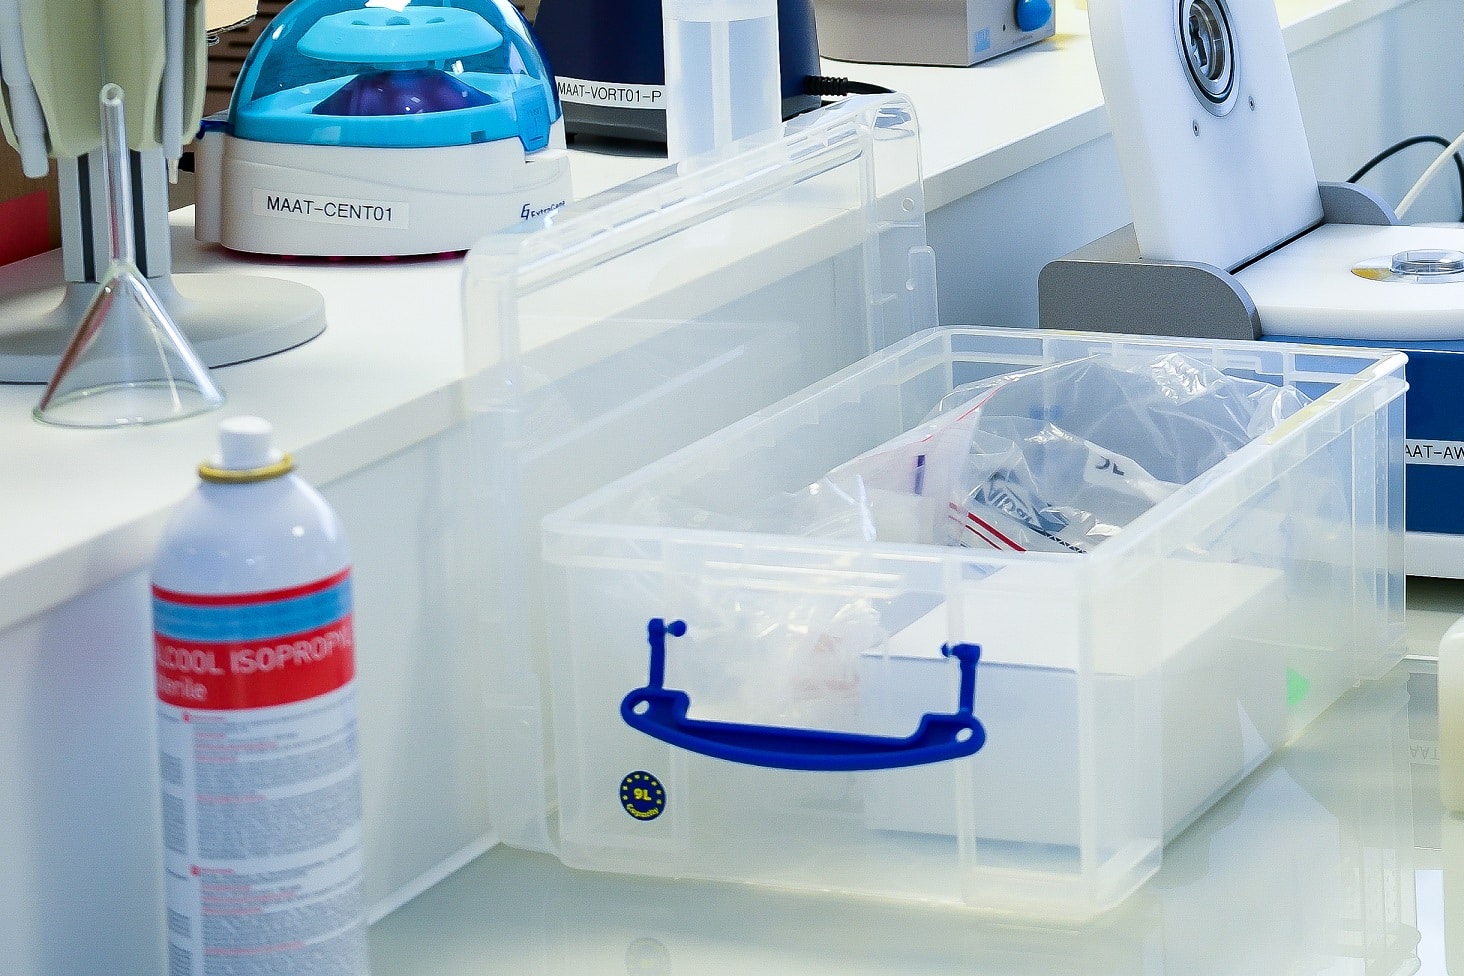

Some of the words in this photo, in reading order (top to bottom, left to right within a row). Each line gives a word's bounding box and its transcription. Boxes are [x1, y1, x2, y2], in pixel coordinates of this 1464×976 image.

[557, 82, 662, 103] MAAT-VORT01-P
[267, 195, 392, 222] MAAT-CENT01
[633, 787, 652, 801] 9L
